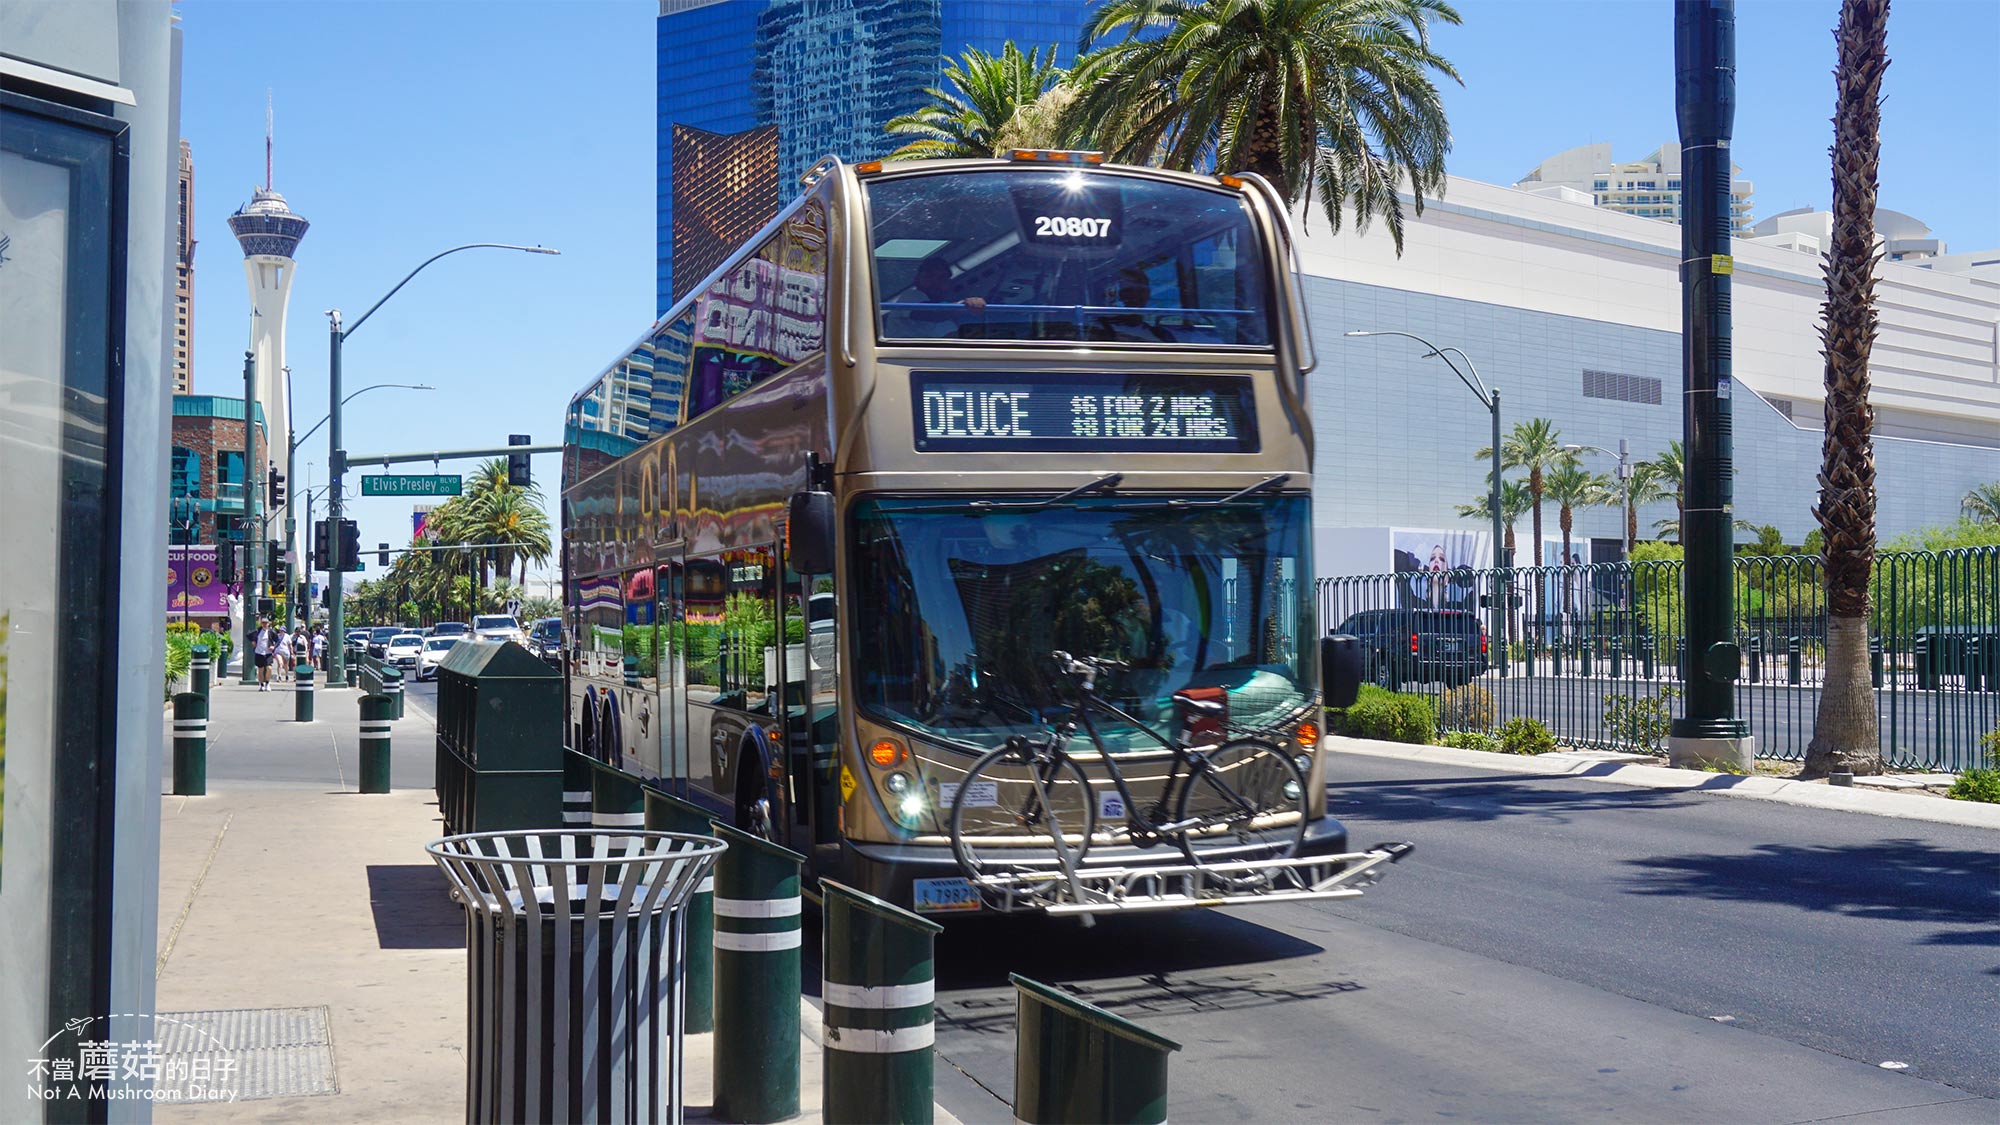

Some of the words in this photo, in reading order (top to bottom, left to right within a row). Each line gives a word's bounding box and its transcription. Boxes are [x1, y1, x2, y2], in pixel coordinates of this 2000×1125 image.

[1035, 216, 1112, 237] 20807
[922, 391, 1032, 436] DEUCE
[1070, 396, 1098, 415] $6
[1103, 396, 1145, 415] FOR
[1150, 396, 1165, 415] 2
[1170, 396, 1213, 415] HRS
[1071, 417, 1099, 436] $8
[1104, 417, 1146, 436] FOR
[1150, 417, 1180, 436] 24
[1185, 417, 1228, 436] HRS
[373, 477, 397, 491] Elvis
[400, 477, 436, 494] Presley
[188, 553, 217, 561] FOOD
